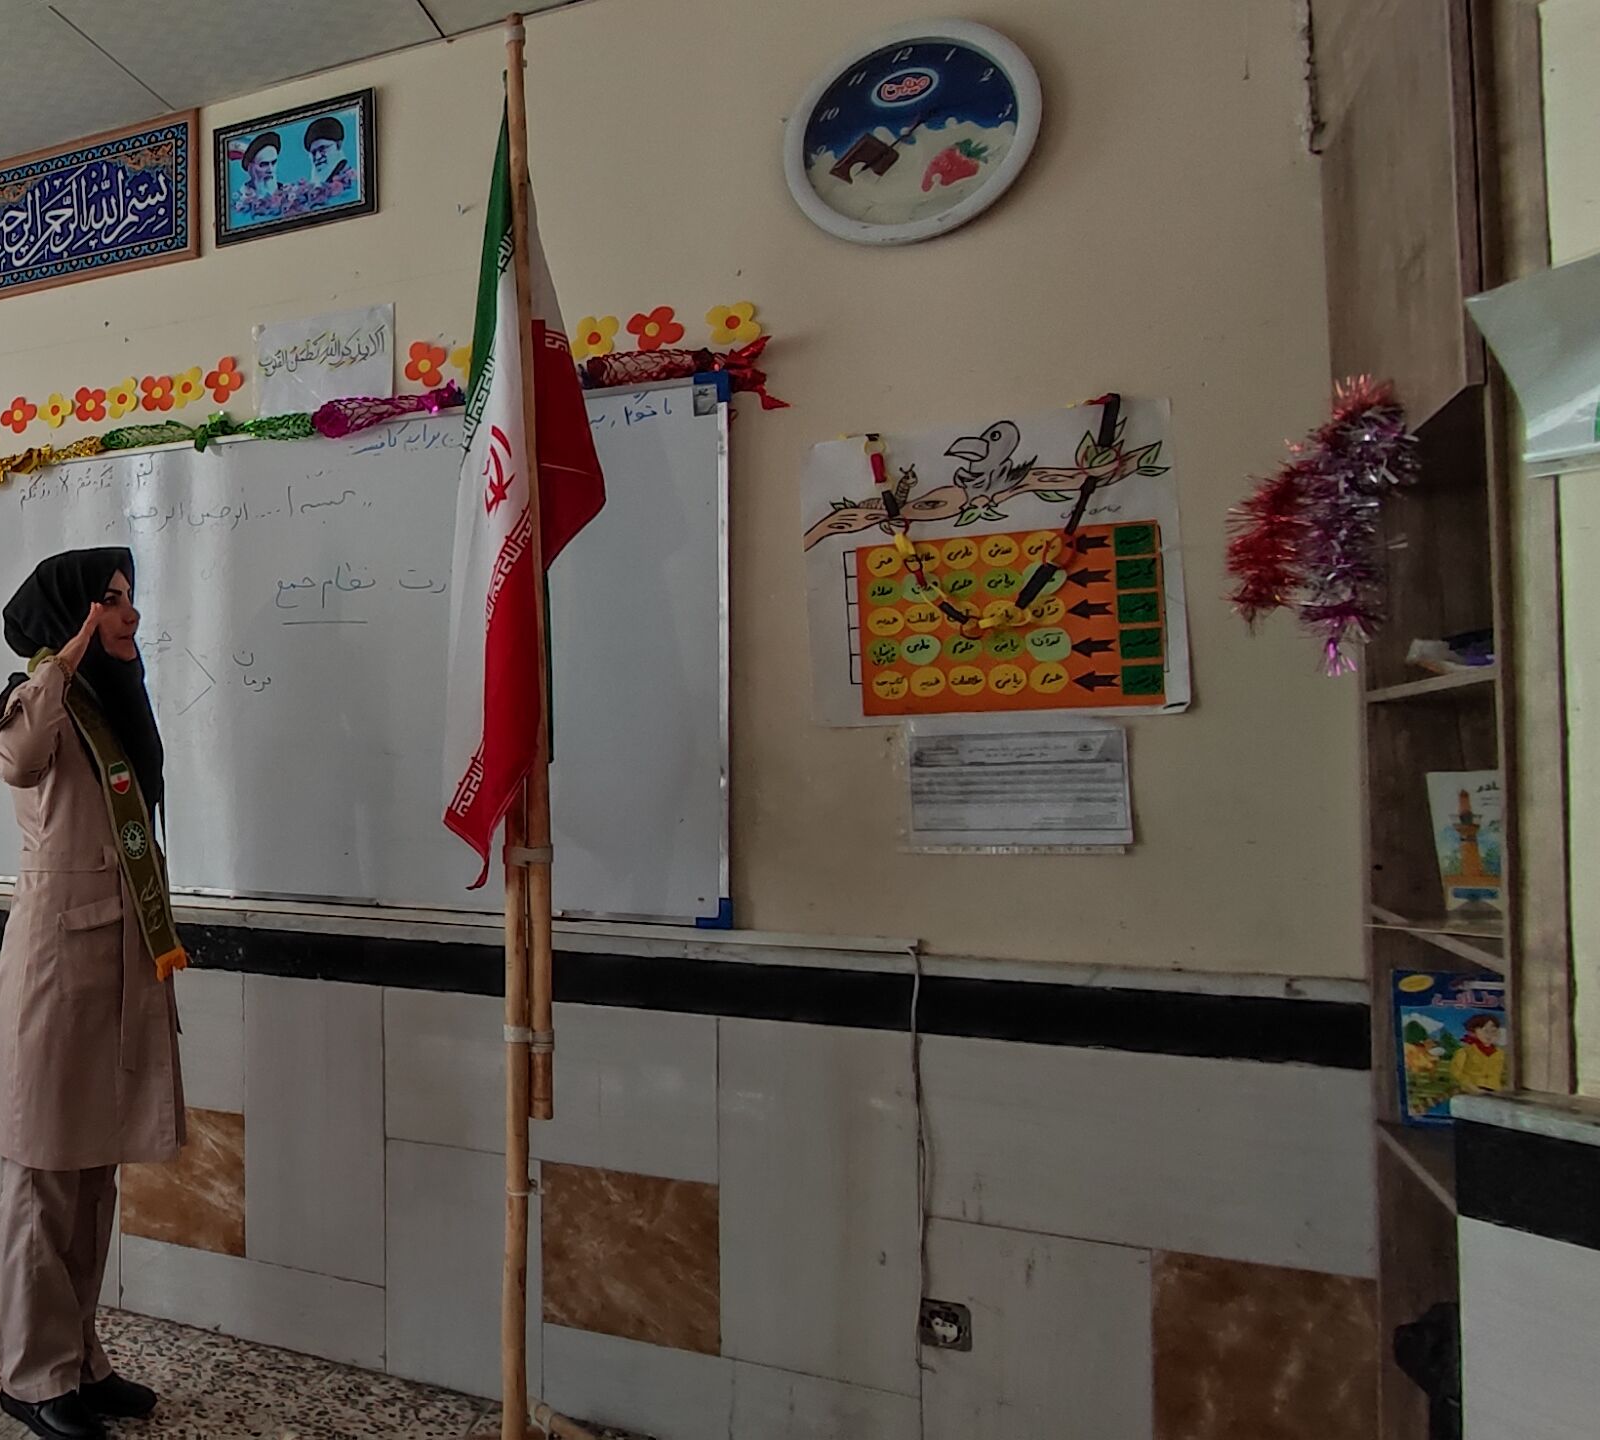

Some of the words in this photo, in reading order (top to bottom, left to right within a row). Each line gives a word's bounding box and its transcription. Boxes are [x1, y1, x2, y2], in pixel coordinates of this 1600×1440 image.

[892, 47, 913, 63] 12
[945, 48, 956, 62] 1
[848, 71, 867, 86] 11
[979, 68, 994, 83] 2
[819, 107, 839, 122] 10
[998, 104, 1013, 118] 3
